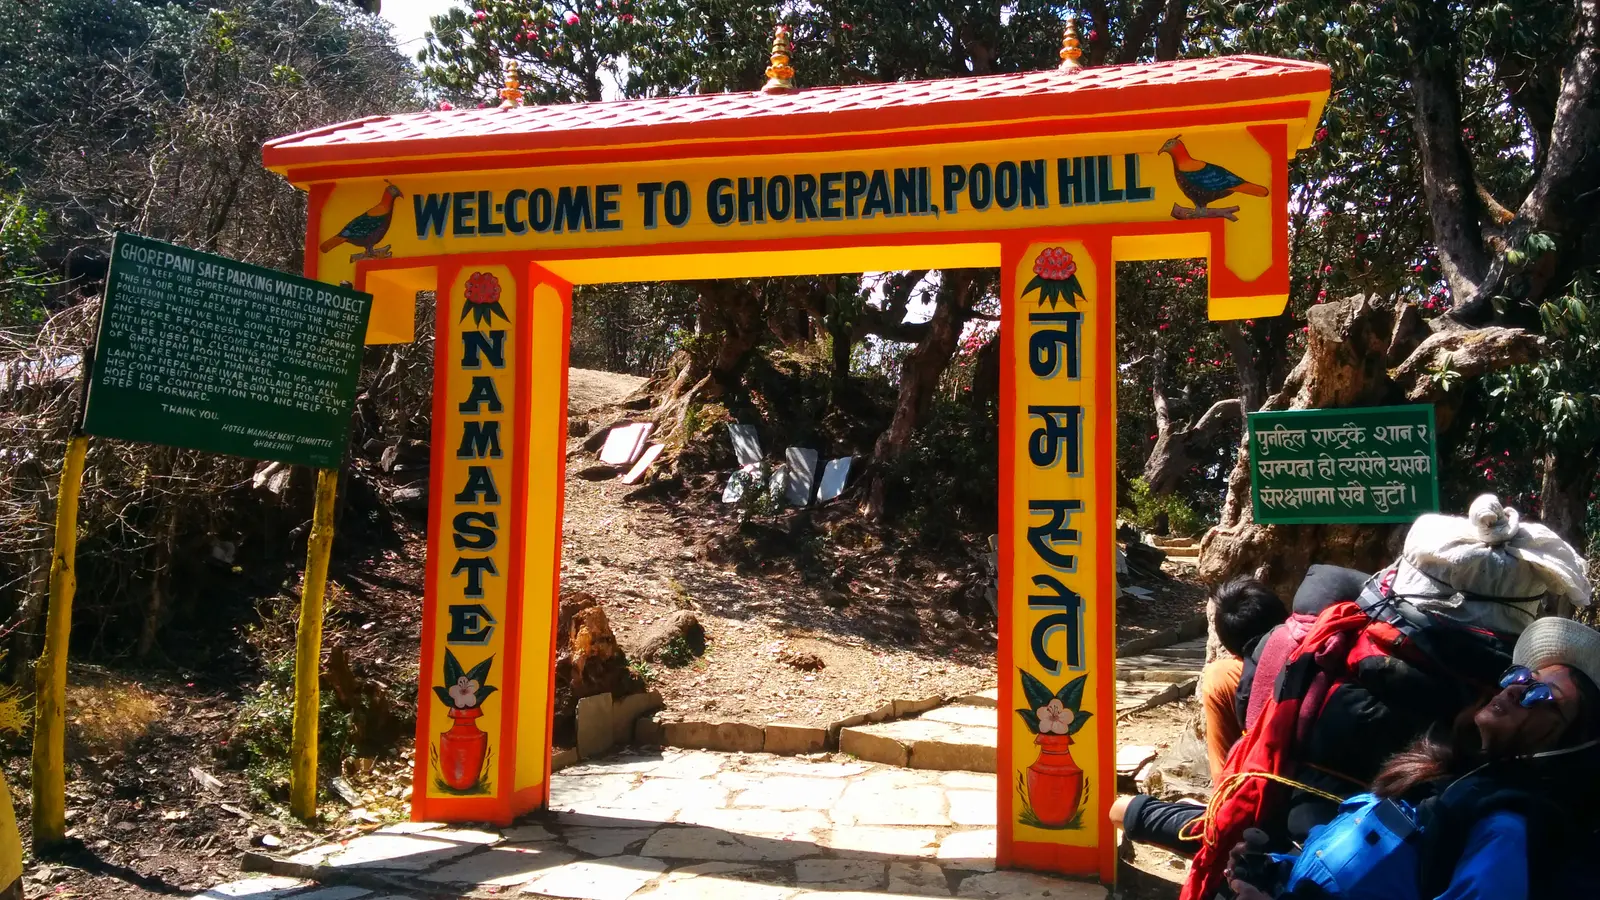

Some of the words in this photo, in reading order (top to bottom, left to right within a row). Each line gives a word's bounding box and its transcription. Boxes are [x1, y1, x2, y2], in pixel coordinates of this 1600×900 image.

[637, 180, 691, 229] TO
[943, 159, 1049, 214] POON
[1057, 153, 1154, 207] HILL
[119, 271, 139, 284] THIS
[142, 277, 152, 286] IS
[155, 280, 173, 290] OUR
[178, 285, 205, 297] FIRST
[208, 292, 249, 307] ATTEMPT
[251, 301, 267, 312] FOR
[270, 305, 306, 321] REDUCING
[308, 314, 322, 325] THE
[325, 319, 356, 333] PLASTIC
[121, 242, 195, 274] GHOREPANI
[197, 261, 225, 281] SAFE
[226, 268, 273, 293] PARKING
[275, 280, 314, 302] WATER
[316, 290, 365, 314] PROJECT
[136, 264, 149, 275] TO
[151, 268, 173, 279] KEEP
[176, 274, 192, 283] OUR
[195, 278, 242, 295] GHOREPANI
[243, 289, 263, 300] POON
[264, 294, 280, 305] HILL
[282, 298, 301, 309] AREA
[303, 303, 327, 315] CLEAN
[327, 309, 340, 319] AND
[113, 303, 135, 314] AND
[140, 308, 170, 322] MORE
[176, 315, 261, 340] PROGRESSIVELY
[266, 334, 290, 346] THIS
[295, 341, 340, 356] PROJECT
[345, 352, 355, 360] IN
[114, 292, 161, 309] SUCCESS
[165, 302, 192, 316] THEN
[196, 310, 212, 320] WE
[216, 314, 239, 327] WILL
[243, 320, 273, 334] GOING
[278, 327, 291, 338] TO
[295, 332, 318, 342] STEP
[320, 337, 356, 352] FORWARD
[116, 281, 164, 299] POLLUTION
[166, 293, 177, 302] IN
[179, 295, 200, 307] THIS
[232, 307, 241, 316] IF
[244, 310, 261, 320] OUR
[264, 314, 303, 329] ATTEMPT
[307, 323, 329, 336] WILL
[333, 330, 352, 340] GET
[109, 329, 123, 337] OF
[128, 333, 190, 350] GHOREPANI
[193, 345, 221, 357] POON
[224, 351, 244, 363] HILL
[110, 321, 135, 333] WILL
[141, 327, 155, 337] BE
[159, 331, 189, 343] USED
[192, 337, 203, 346] IN
[208, 340, 258, 357] CLEANING
[261, 351, 279, 361] AND
[282, 356, 348, 375] CONSERVATION
[111, 312, 155, 328] FUTURE
[189, 328, 206, 338] ALL
[210, 332, 248, 347] INCOME
[253, 340, 279, 352] FROM
[281, 346, 303, 358] THIS
[306, 351, 348, 366] PROJECT
[102, 376, 133, 388] STEP
[138, 381, 153, 392] US
[104, 366, 134, 381] HOPE
[139, 372, 161, 387] FOR
[166, 377, 247, 399] CONTRIBUTION
[250, 392, 269, 402] TOO
[273, 396, 292, 407] AND
[296, 400, 321, 412] HELP
[325, 405, 339, 416] TO
[106, 357, 125, 367] HIS
[128, 361, 214, 383] CONTRIBUTIONS
[219, 377, 232, 386] TO
[236, 380, 267, 393] BEGIN
[269, 386, 290, 397] THIS
[333, 398, 347, 408] WE
[107, 347, 135, 359] LAAN
[138, 353, 153, 362] OF
[158, 357, 192, 371] NEPAL
[198, 364, 245, 381] PARIWAR
[251, 375, 293, 389] HOLLAND
[295, 383, 313, 392] FOR
[318, 388, 335, 398] ALL
[130, 342, 145, 352] WE
[150, 346, 171, 357] ARE
[176, 351, 220, 366] HEARTLY
[224, 360, 273, 377] THANKFUL
[277, 370, 290, 379] TO
[313, 379, 338, 389] JAAN
[161, 403, 197, 417] THANK
[221, 423, 245, 435] HOTEL
[246, 427, 296, 441] MANAGEMENT
[296, 435, 333, 448] COMMITTEE
[253, 439, 294, 451] GHOREPANI
[1255, 424, 1308, 455] पुनहिल
[1373, 424, 1414, 445] शान
[1417, 424, 1428, 444] र
[446, 330, 505, 645] NAMASTE
[1257, 459, 1315, 480] सम्पदा
[1317, 452, 1336, 481] हो
[1338, 451, 1386, 479] त्यसैले
[1387, 450, 1431, 478] यसको
[1259, 485, 1336, 509] संरक्षणमा
[1337, 480, 1367, 508] सबै
